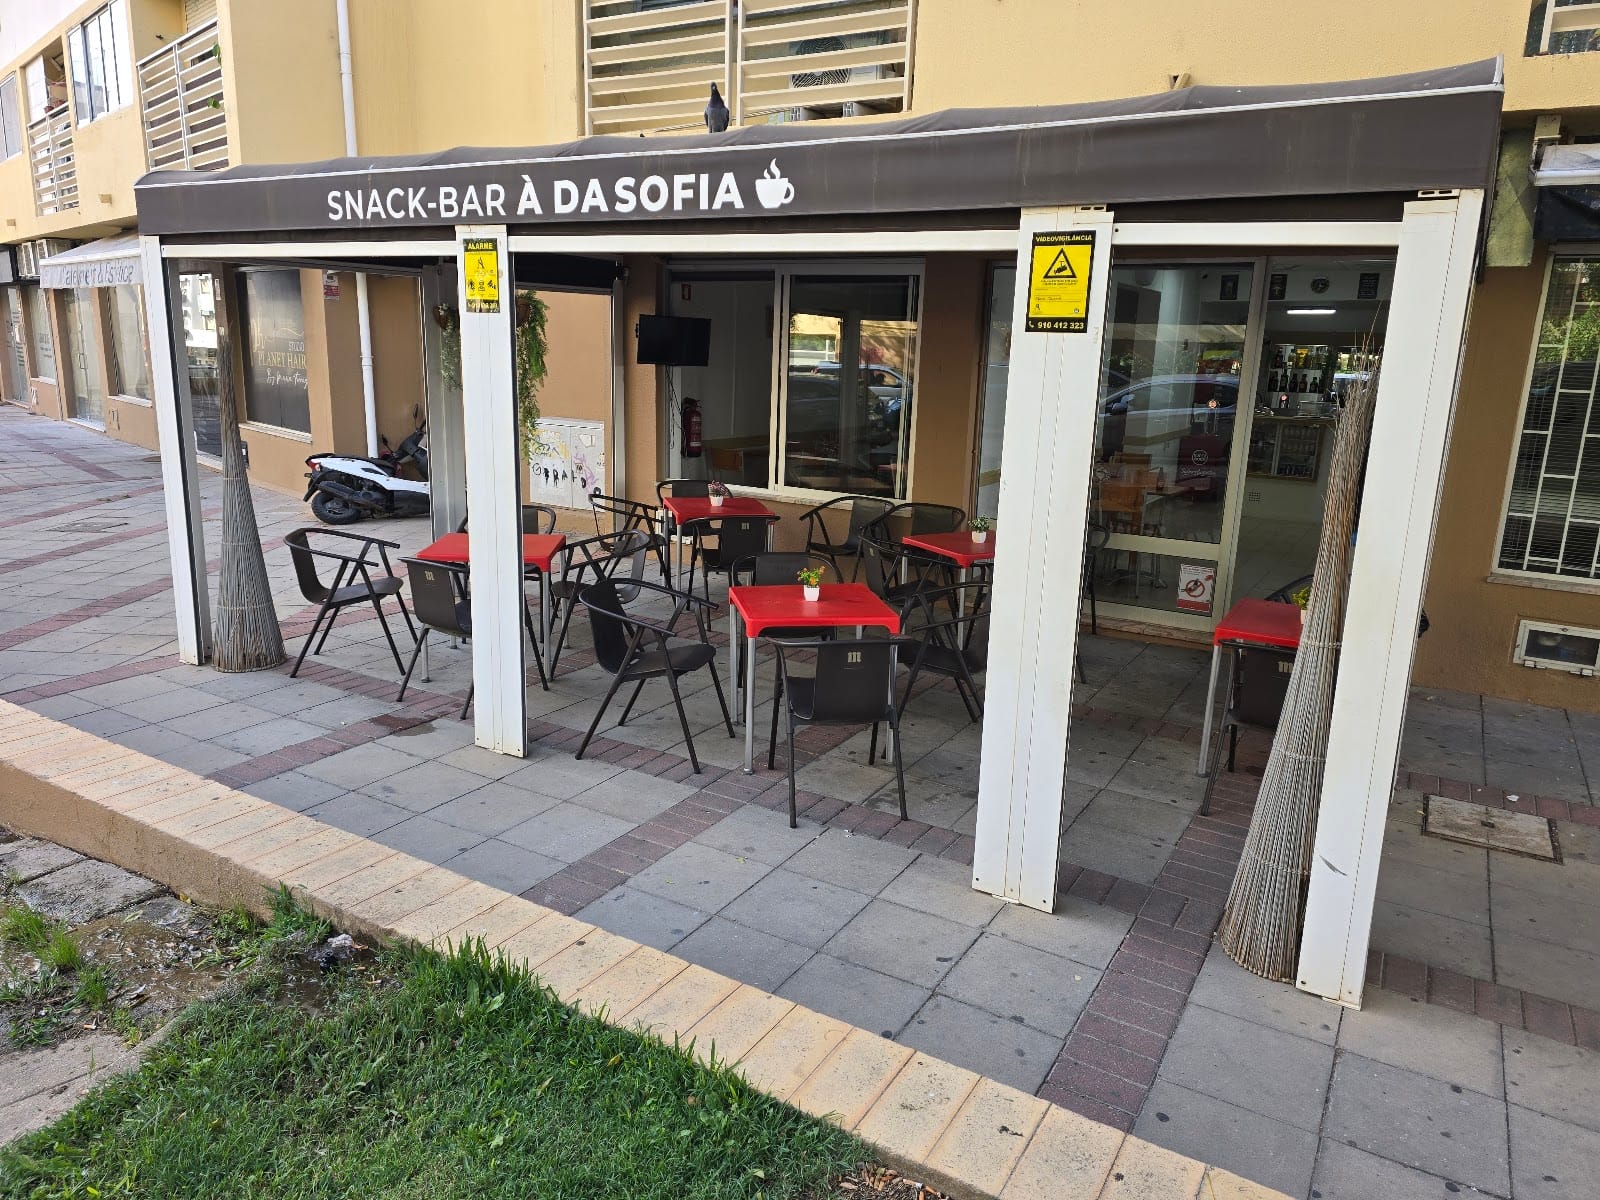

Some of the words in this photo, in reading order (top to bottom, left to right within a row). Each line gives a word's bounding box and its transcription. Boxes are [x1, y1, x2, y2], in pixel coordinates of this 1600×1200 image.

[327, 183, 506, 221] SNACK-BAR
[516, 174, 543, 215] À
[1037, 321, 1052, 329] 910
[1053, 321, 1068, 329] 412
[1069, 321, 1084, 329] 323
[258, 351, 286, 367] PLANET
[287, 352, 307, 369] HAIR
